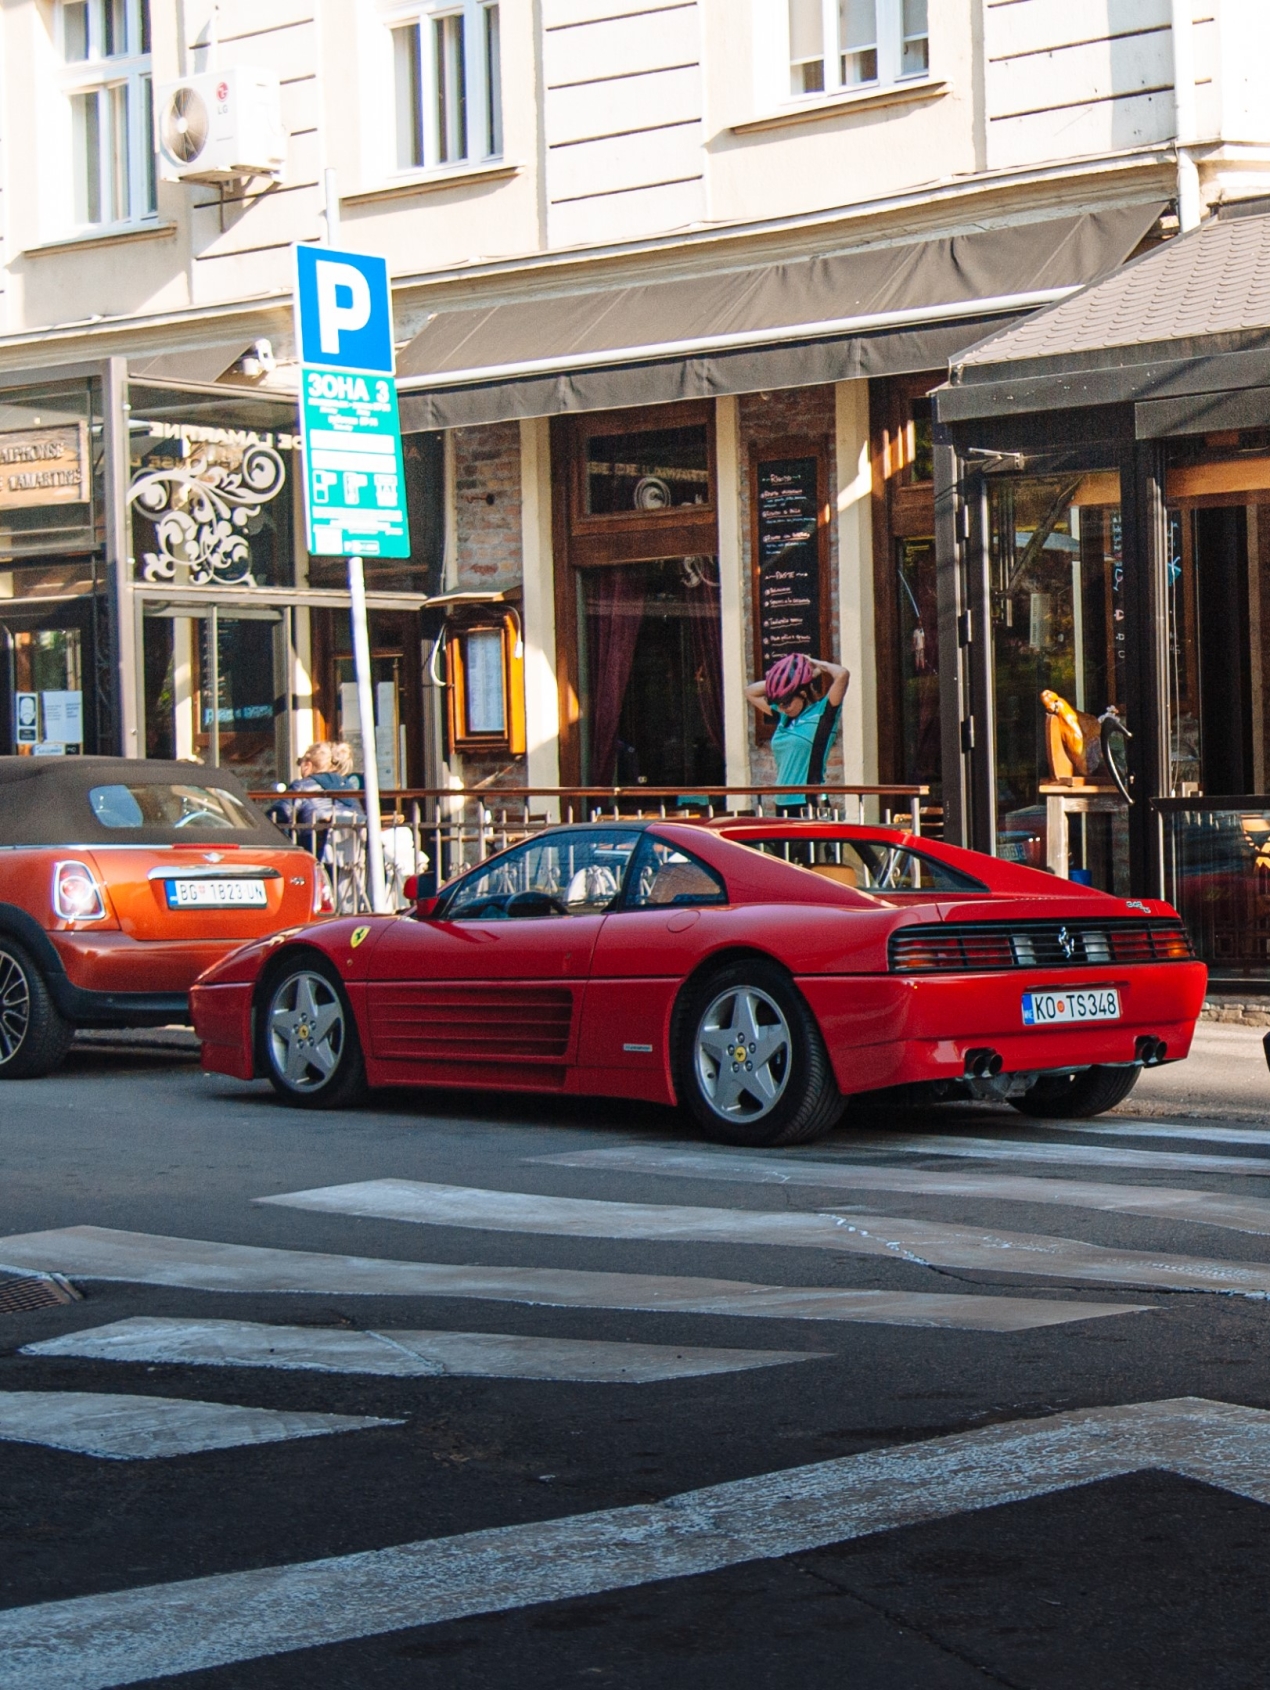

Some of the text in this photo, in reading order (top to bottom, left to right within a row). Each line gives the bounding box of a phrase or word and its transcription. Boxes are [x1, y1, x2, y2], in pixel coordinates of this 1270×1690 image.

[217, 104, 229, 115] LG
[316, 259, 371, 355] P
[308, 373, 390, 402] ЗОНА 3
[180, 884, 198, 900] BG
[1035, 996, 1056, 1020] KO
[1066, 992, 1116, 1018] TS348
